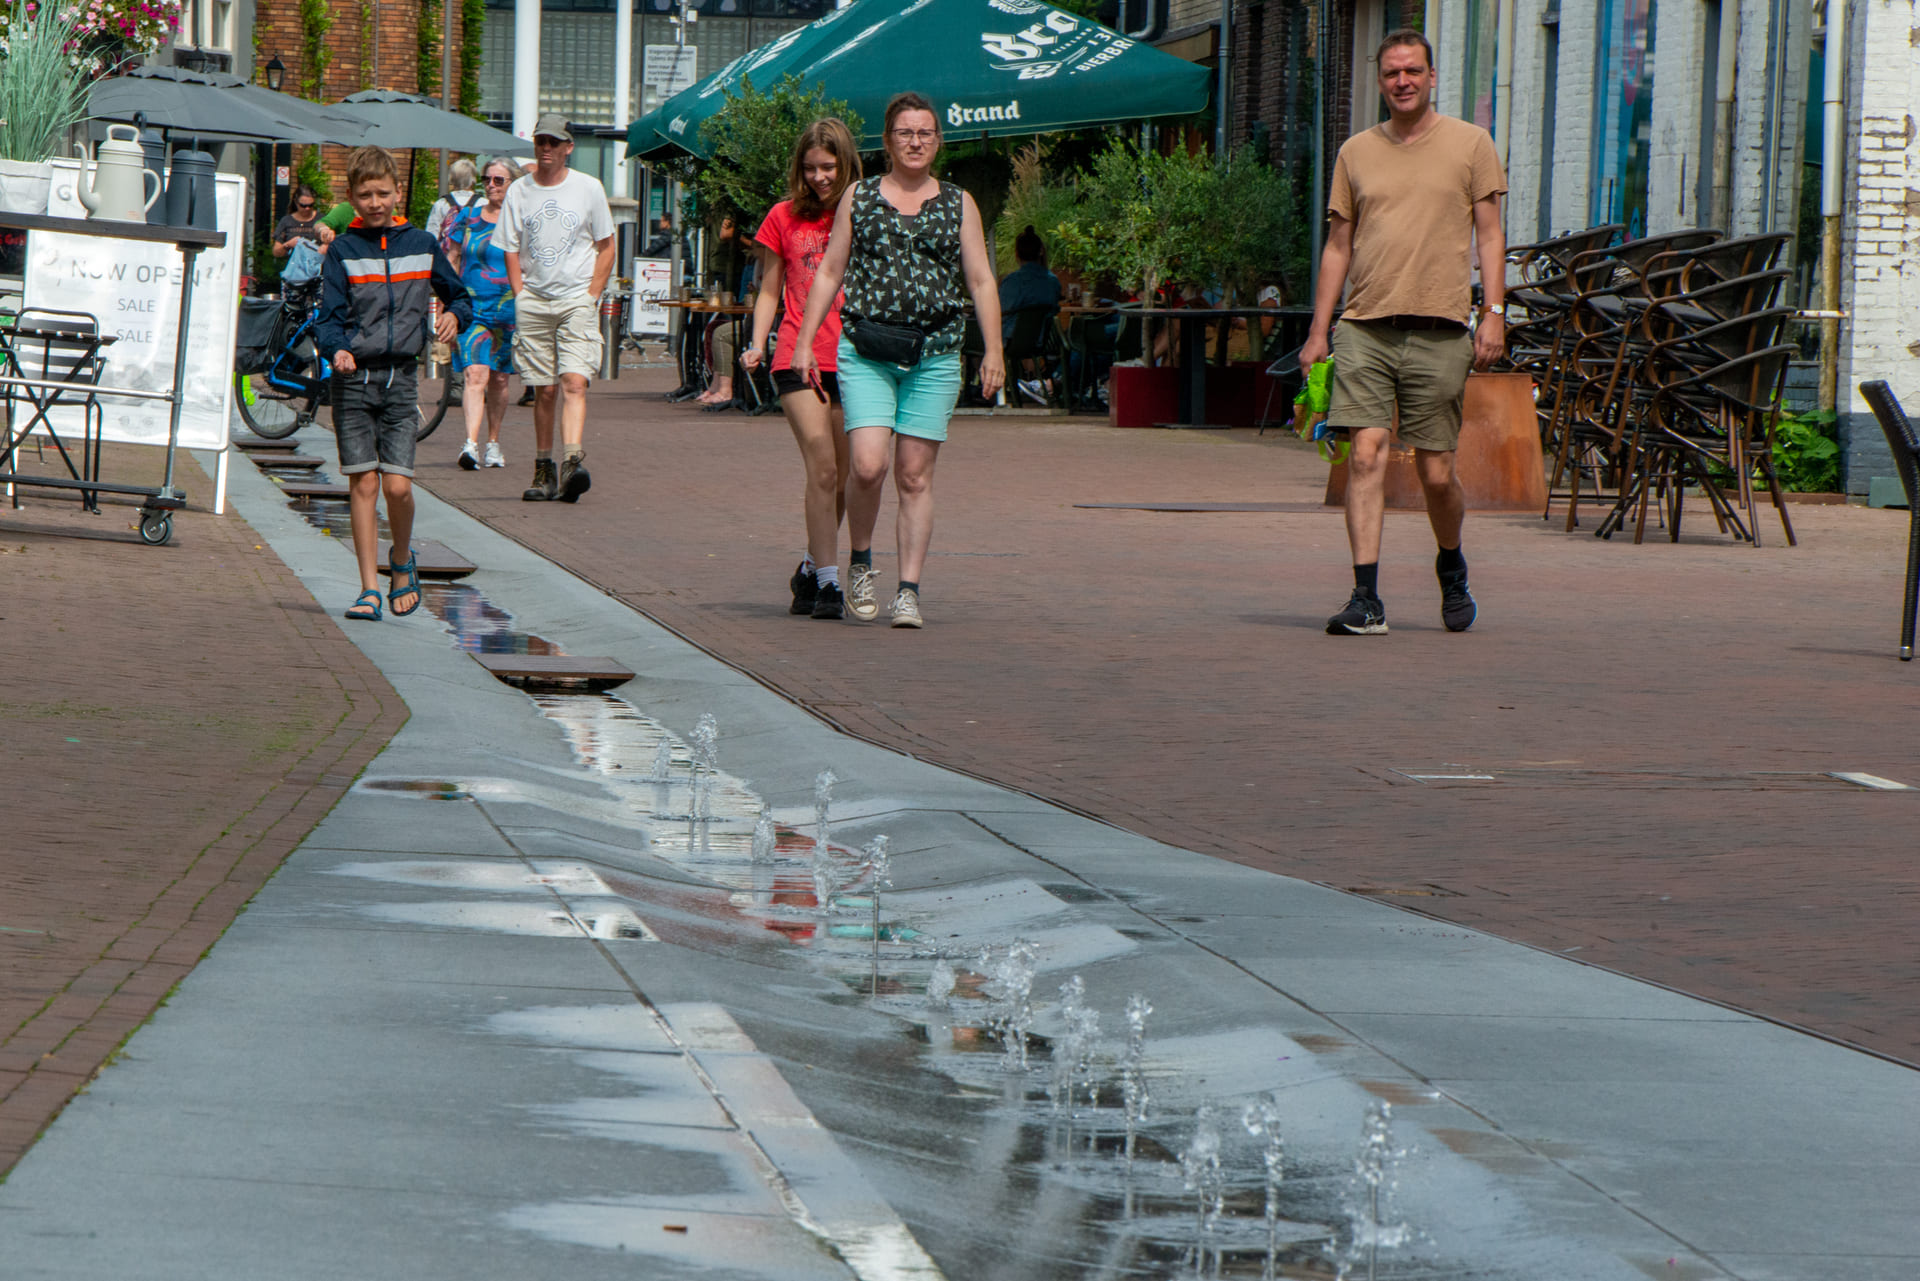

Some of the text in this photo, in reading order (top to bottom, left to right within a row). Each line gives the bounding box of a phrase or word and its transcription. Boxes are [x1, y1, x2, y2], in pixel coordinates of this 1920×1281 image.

[947, 100, 1021, 127] Brand
[117, 298, 156, 313] SALE
[116, 328, 153, 343] SALE
